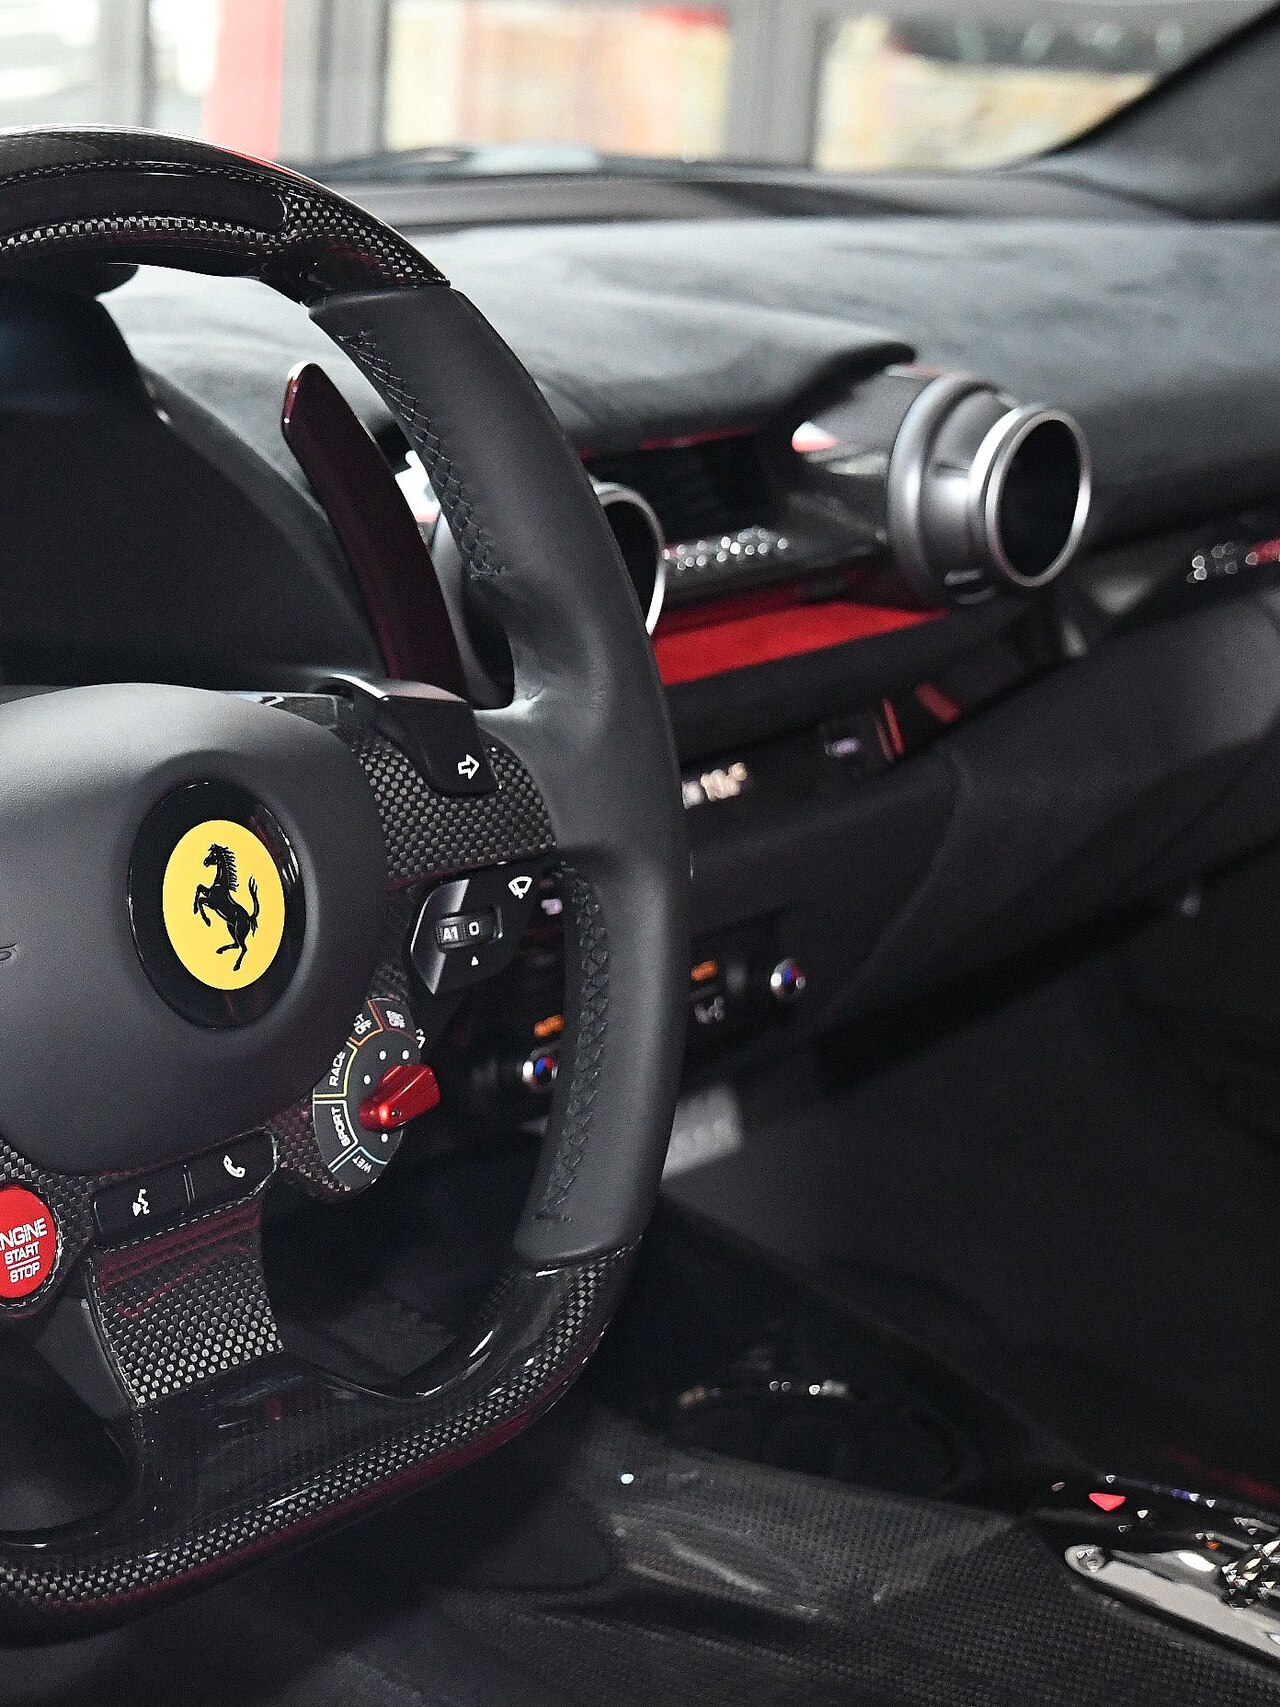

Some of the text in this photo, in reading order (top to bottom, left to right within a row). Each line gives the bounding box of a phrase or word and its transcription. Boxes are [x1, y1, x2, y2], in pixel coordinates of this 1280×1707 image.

[329, 1051, 346, 1087] RACE
[331, 1106, 352, 1147] SPORT
[352, 1156, 373, 1174] WET
[4, 1240, 40, 1265] START
[9, 1261, 41, 1283] STOP
